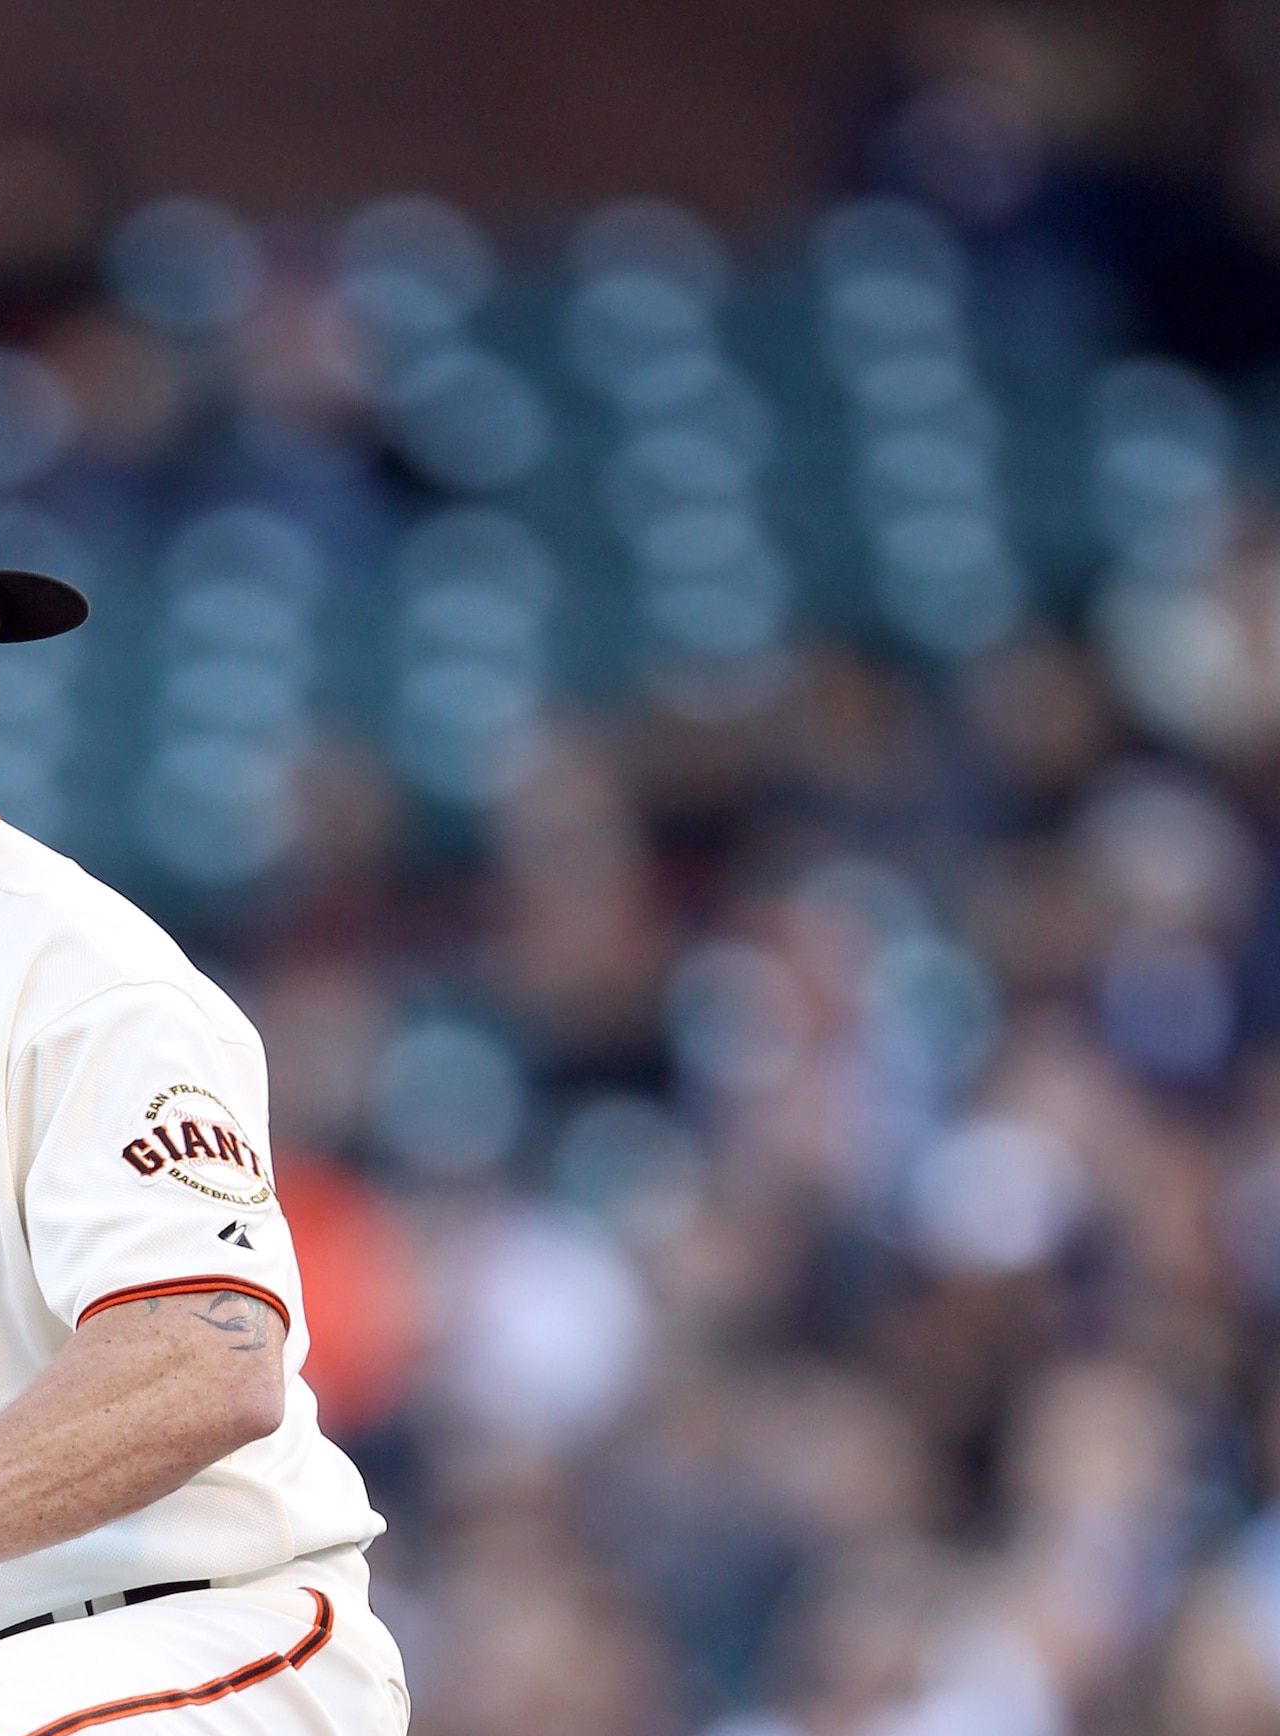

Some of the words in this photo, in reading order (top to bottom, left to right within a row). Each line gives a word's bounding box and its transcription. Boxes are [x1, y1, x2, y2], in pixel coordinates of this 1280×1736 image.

[145, 1093, 169, 1121] SAN
[121, 1121, 264, 1178] GIANT
[168, 1167, 250, 1206] BASEBALL
